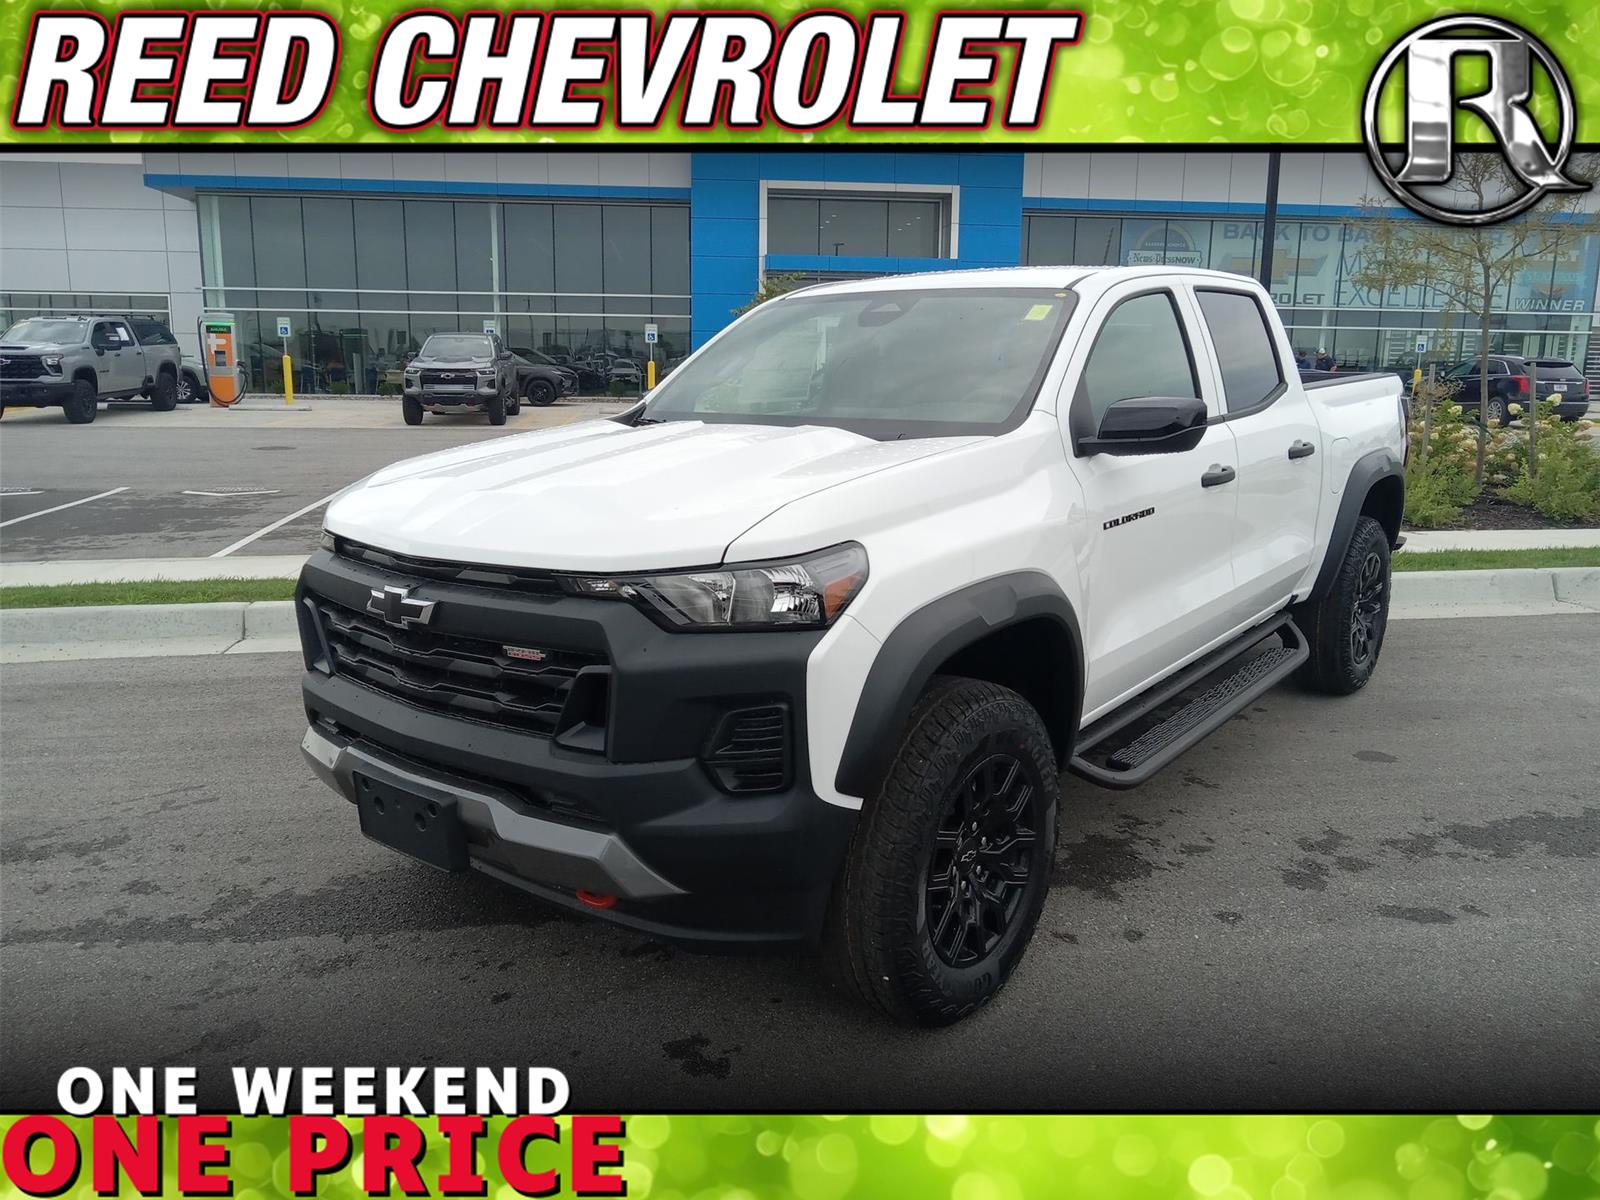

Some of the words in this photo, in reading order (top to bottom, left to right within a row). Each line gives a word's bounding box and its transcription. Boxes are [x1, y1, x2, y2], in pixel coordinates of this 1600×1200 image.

[1302, 225, 1329, 241] TO
[1515, 297, 1585, 312] WINNER
[1103, 507, 1155, 530] COLORADO
